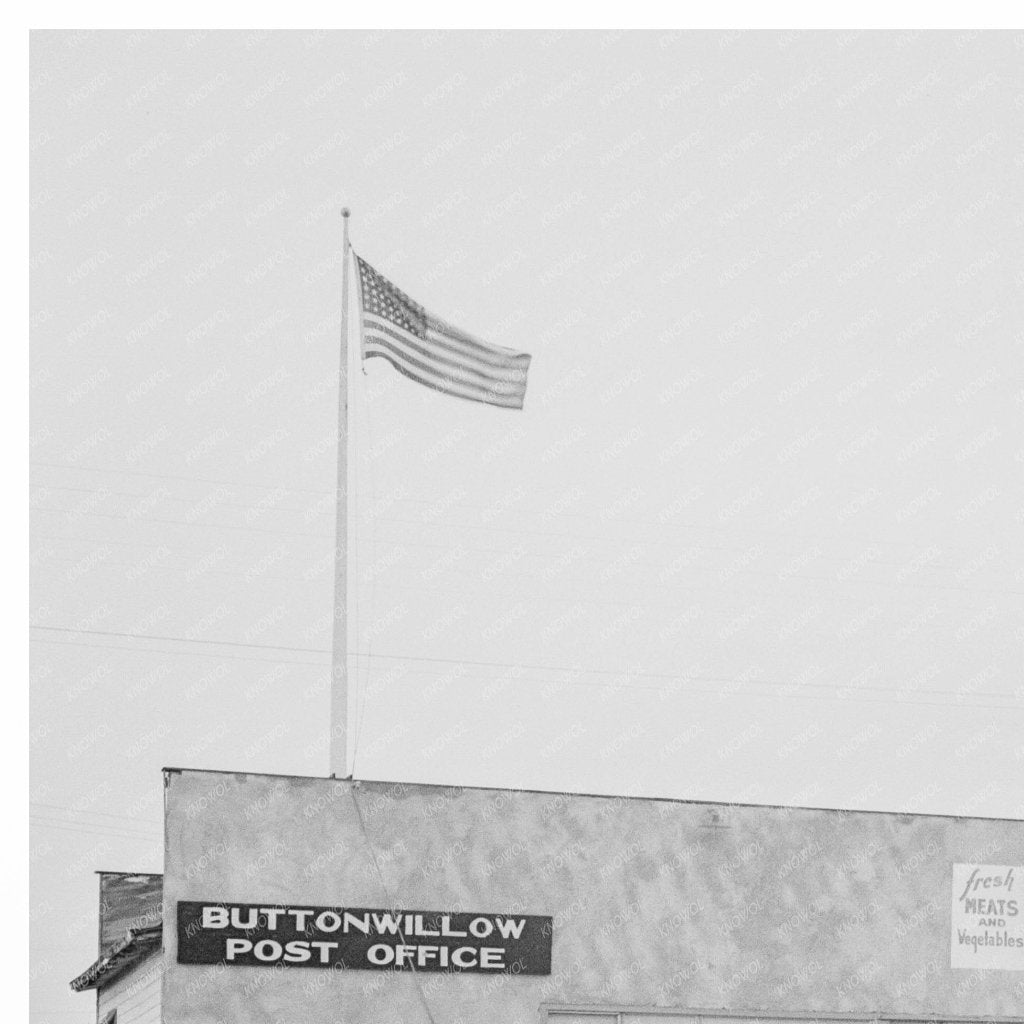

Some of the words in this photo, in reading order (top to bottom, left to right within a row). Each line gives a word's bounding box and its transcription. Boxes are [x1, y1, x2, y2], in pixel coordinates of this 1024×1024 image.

[960, 868, 1015, 901] fresh
[965, 898, 1019, 916] MEATS
[202, 907, 526, 939] BUTTONWILLOW
[979, 918, 1006, 927] AND
[226, 938, 338, 963] POST
[367, 944, 505, 968] OFFICE
[957, 928, 1024, 953] Vegetables
